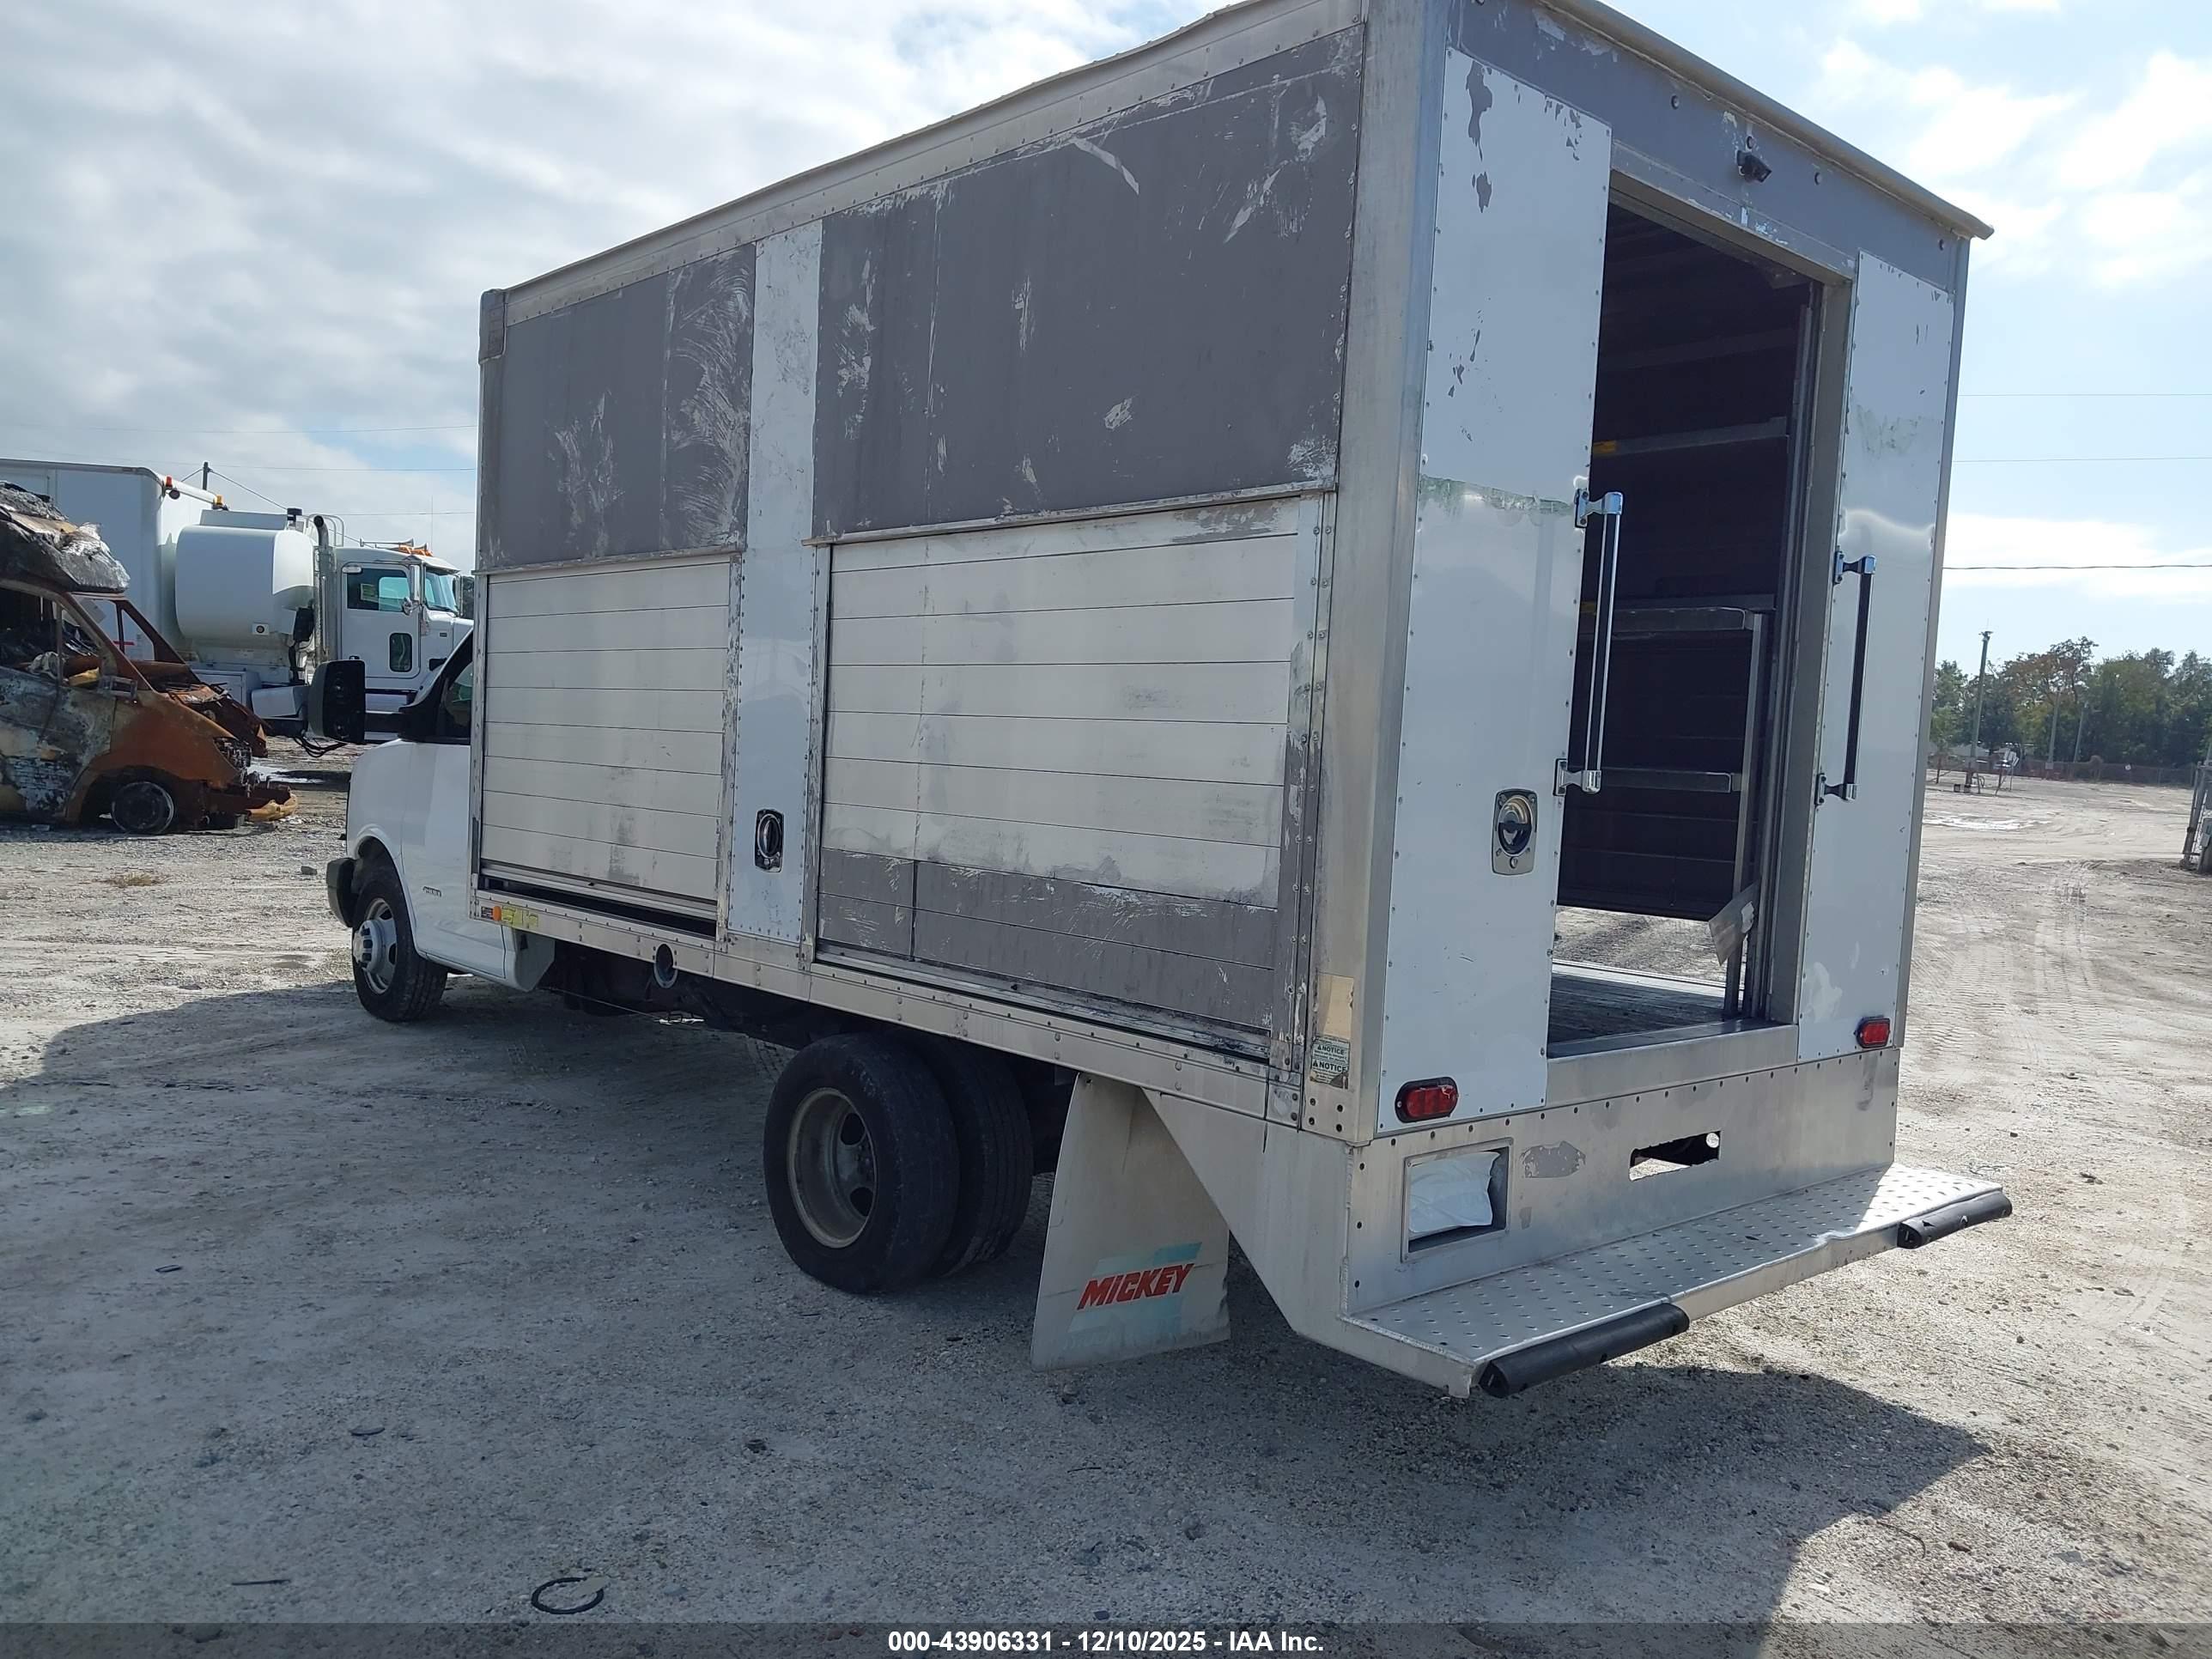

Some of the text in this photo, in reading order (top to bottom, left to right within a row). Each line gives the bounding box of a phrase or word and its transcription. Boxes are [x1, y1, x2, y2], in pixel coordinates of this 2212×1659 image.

[1322, 1045, 1345, 1055] NOTICE
[1320, 1061, 1346, 1073] NOTICE
[1076, 1262, 1195, 1310] MICKEY
